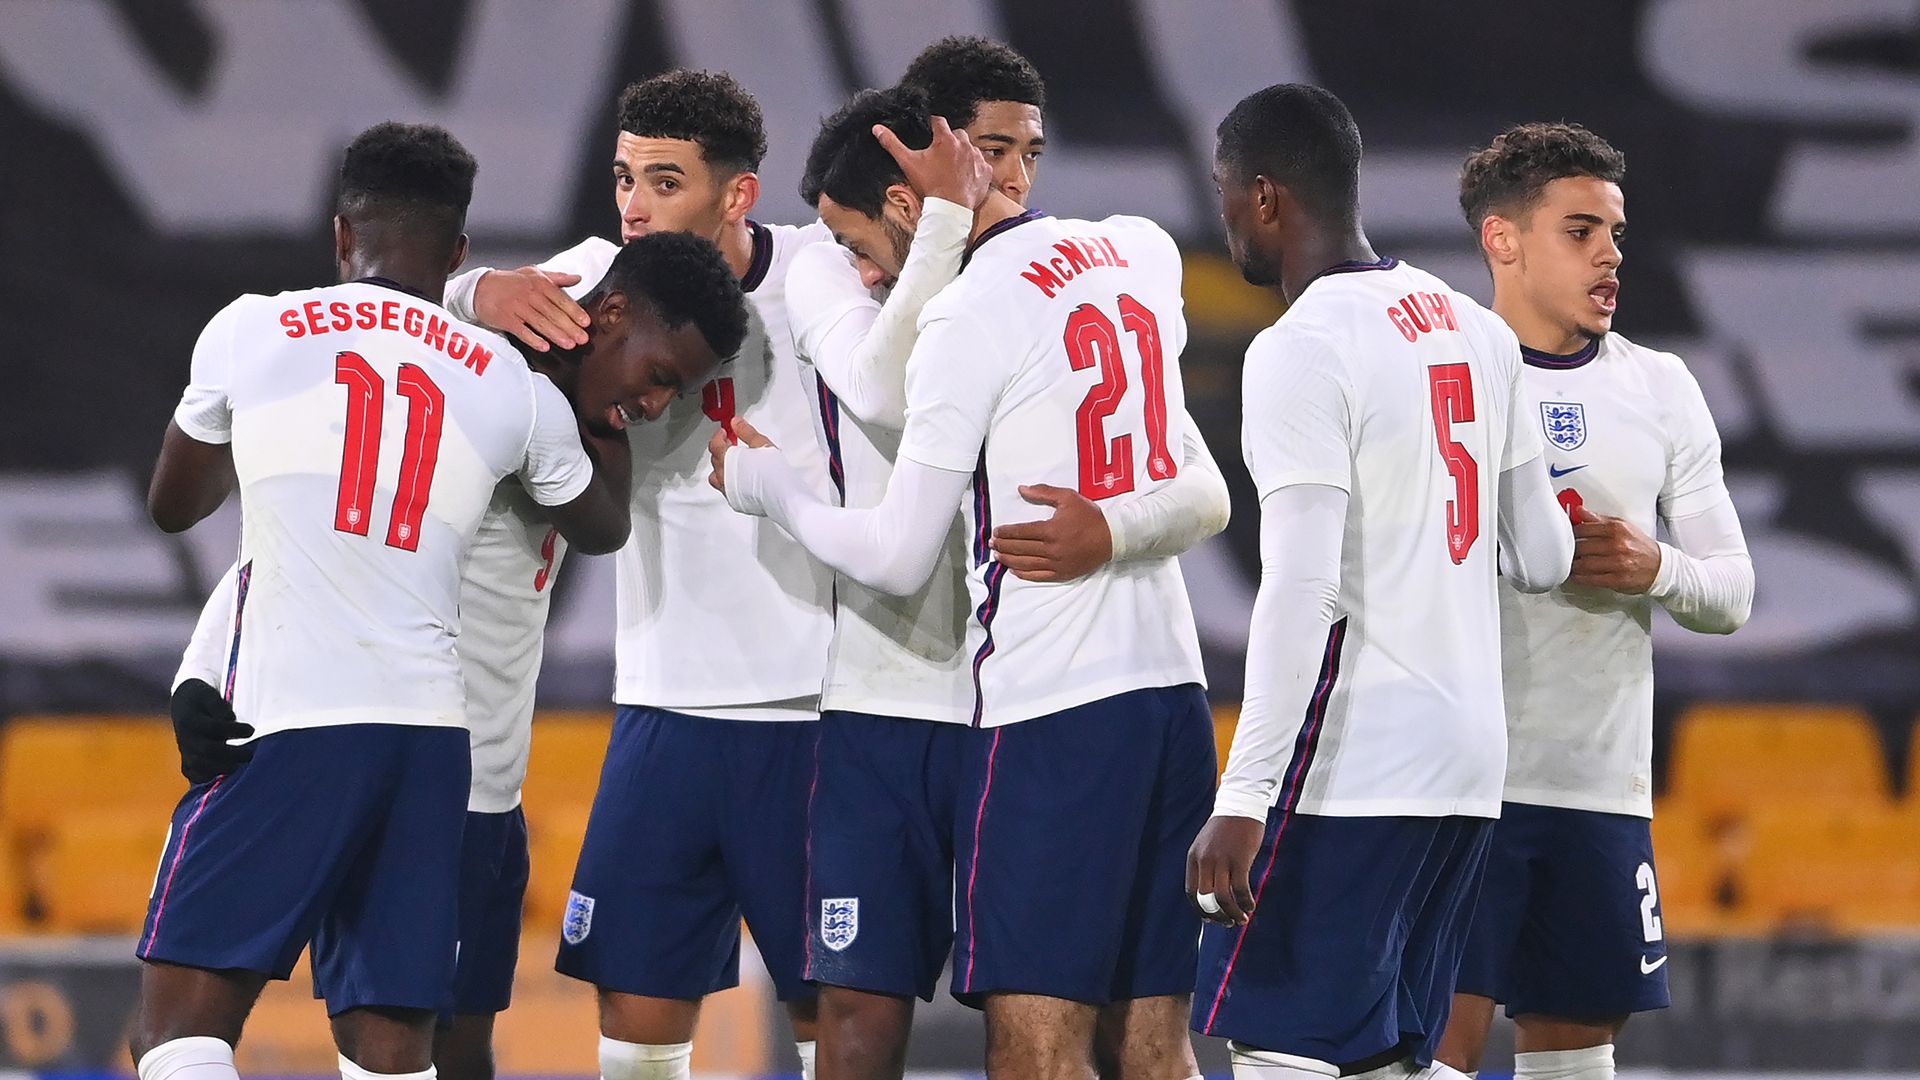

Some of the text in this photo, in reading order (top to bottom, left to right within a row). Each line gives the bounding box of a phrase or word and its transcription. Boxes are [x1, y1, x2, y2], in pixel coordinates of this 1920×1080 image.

[279, 300, 494, 377] SESSEGNON
[1019, 236, 1129, 299] McNEIL
[334, 350, 445, 553] 11
[1062, 293, 1178, 501] 21
[1428, 362, 1479, 565] 5
[1636, 862, 1662, 943] 2
